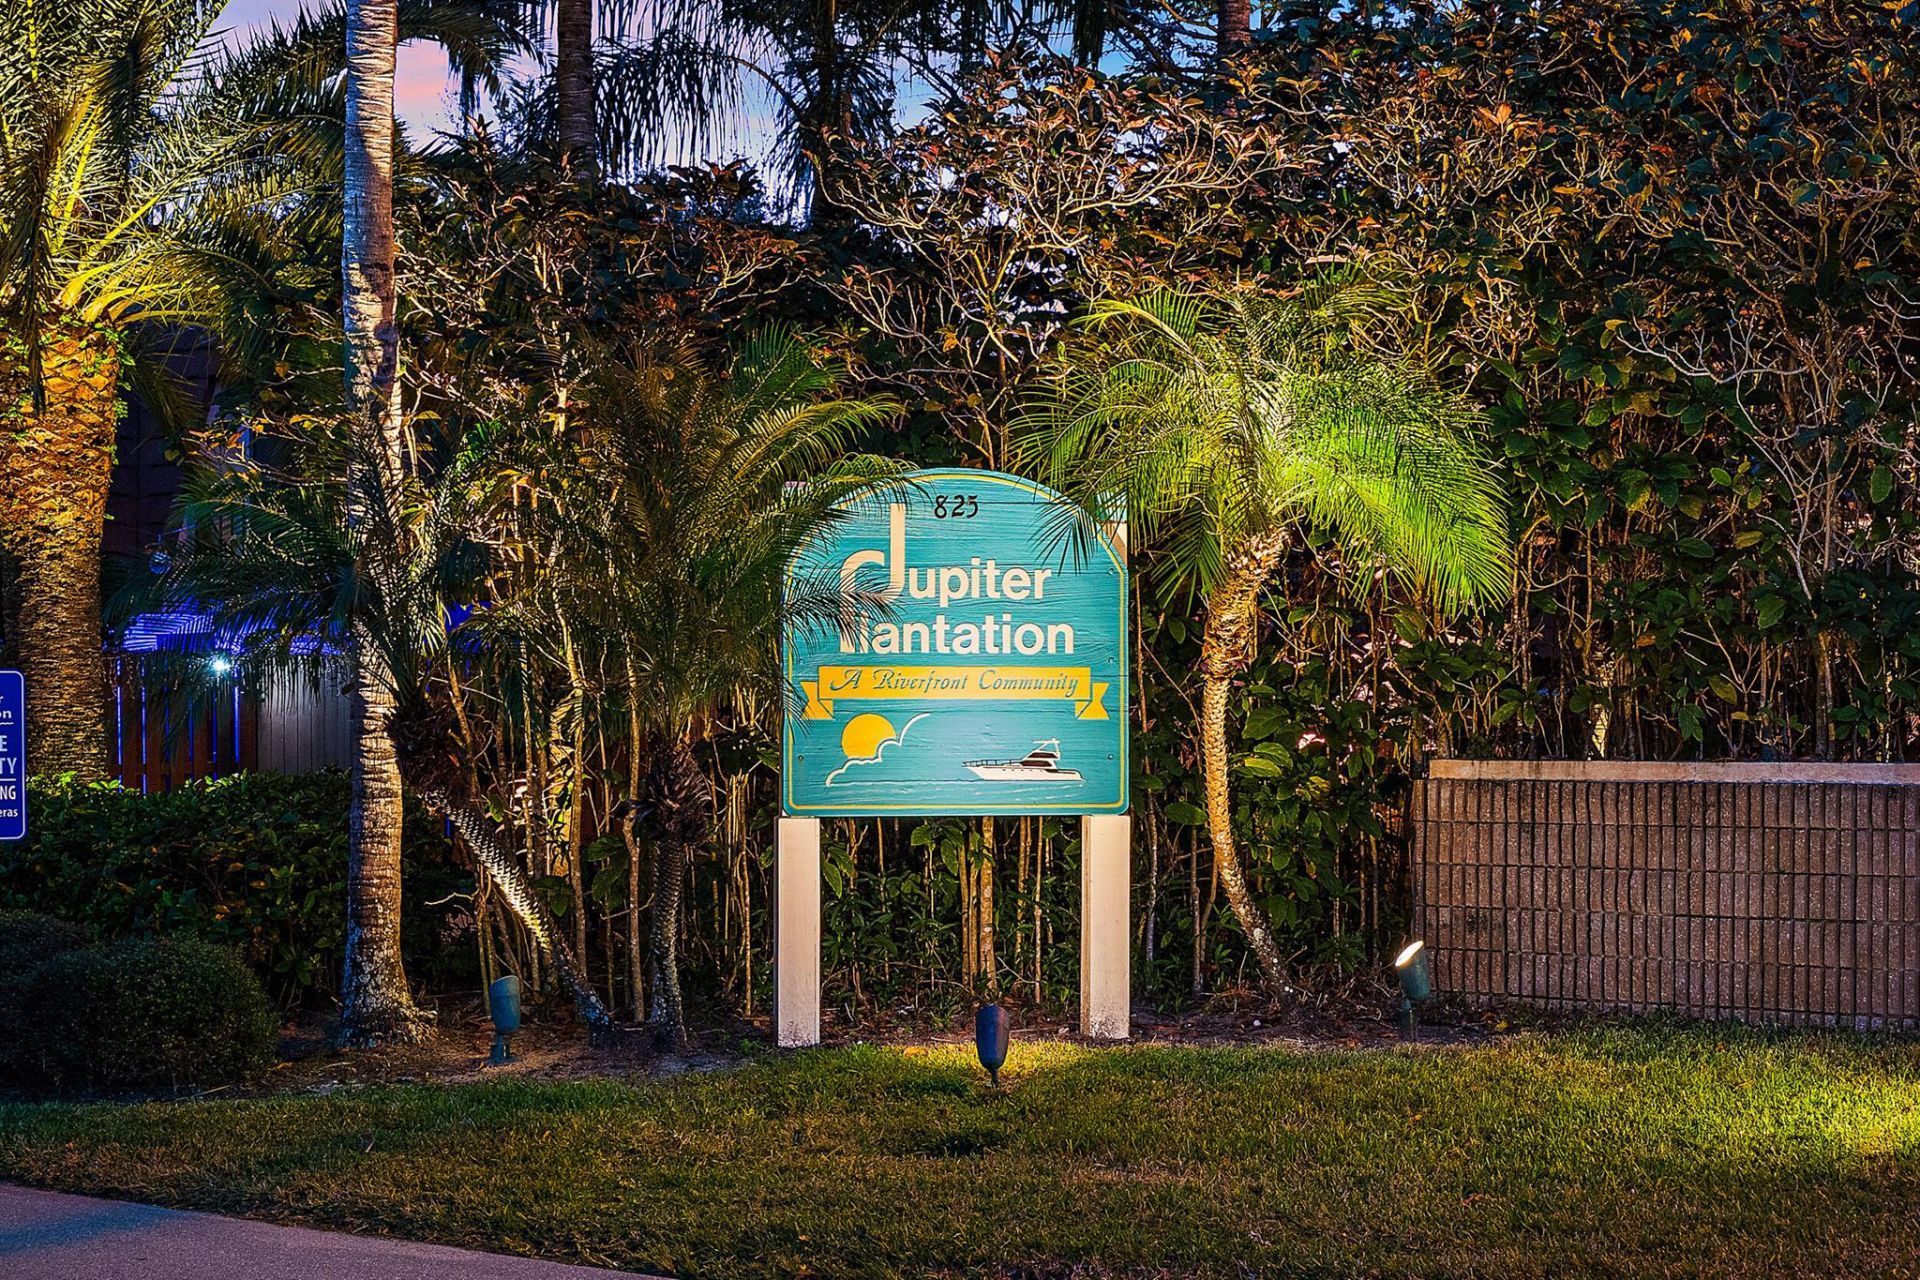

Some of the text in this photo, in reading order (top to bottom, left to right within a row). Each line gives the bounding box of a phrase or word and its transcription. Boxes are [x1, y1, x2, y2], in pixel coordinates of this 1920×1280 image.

[934, 494, 979, 519] 825
[858, 503, 1052, 608] Jupiter
[830, 669, 1079, 698] A Riverfront Community
